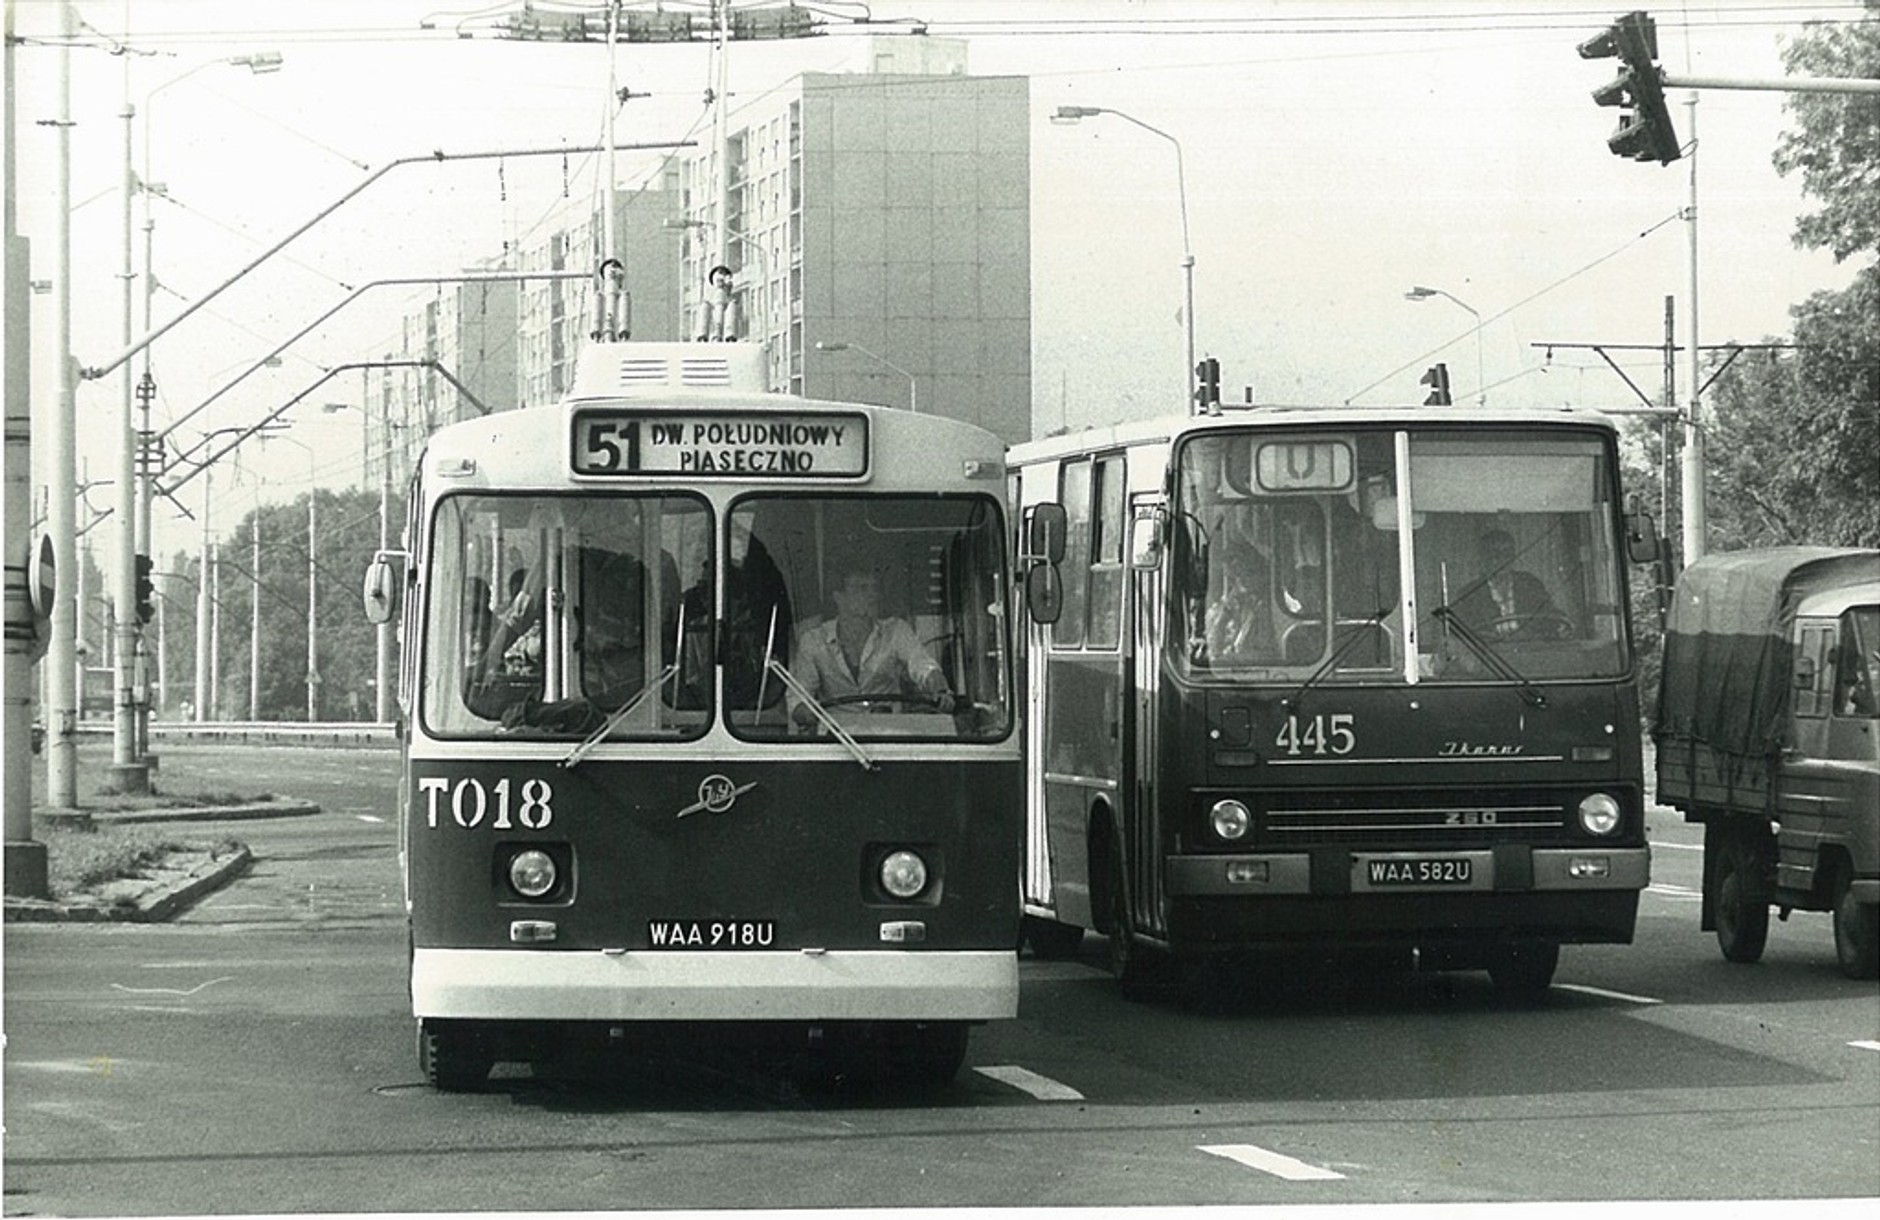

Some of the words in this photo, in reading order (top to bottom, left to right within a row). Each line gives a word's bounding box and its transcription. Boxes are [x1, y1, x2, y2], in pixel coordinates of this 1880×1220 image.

[588, 422, 641, 470] 51
[652, 424, 688, 445] DW.
[694, 424, 845, 446] POŁUDNIOWY
[680, 450, 814, 471] PIASECZNO
[1275, 714, 1356, 755] 445
[1438, 742, 1523, 756] Ikarus
[1371, 862, 1414, 881] WAA
[1419, 862, 1469, 881] 582U
[650, 922, 703, 946] WAA
[710, 922, 773, 946] 918U
